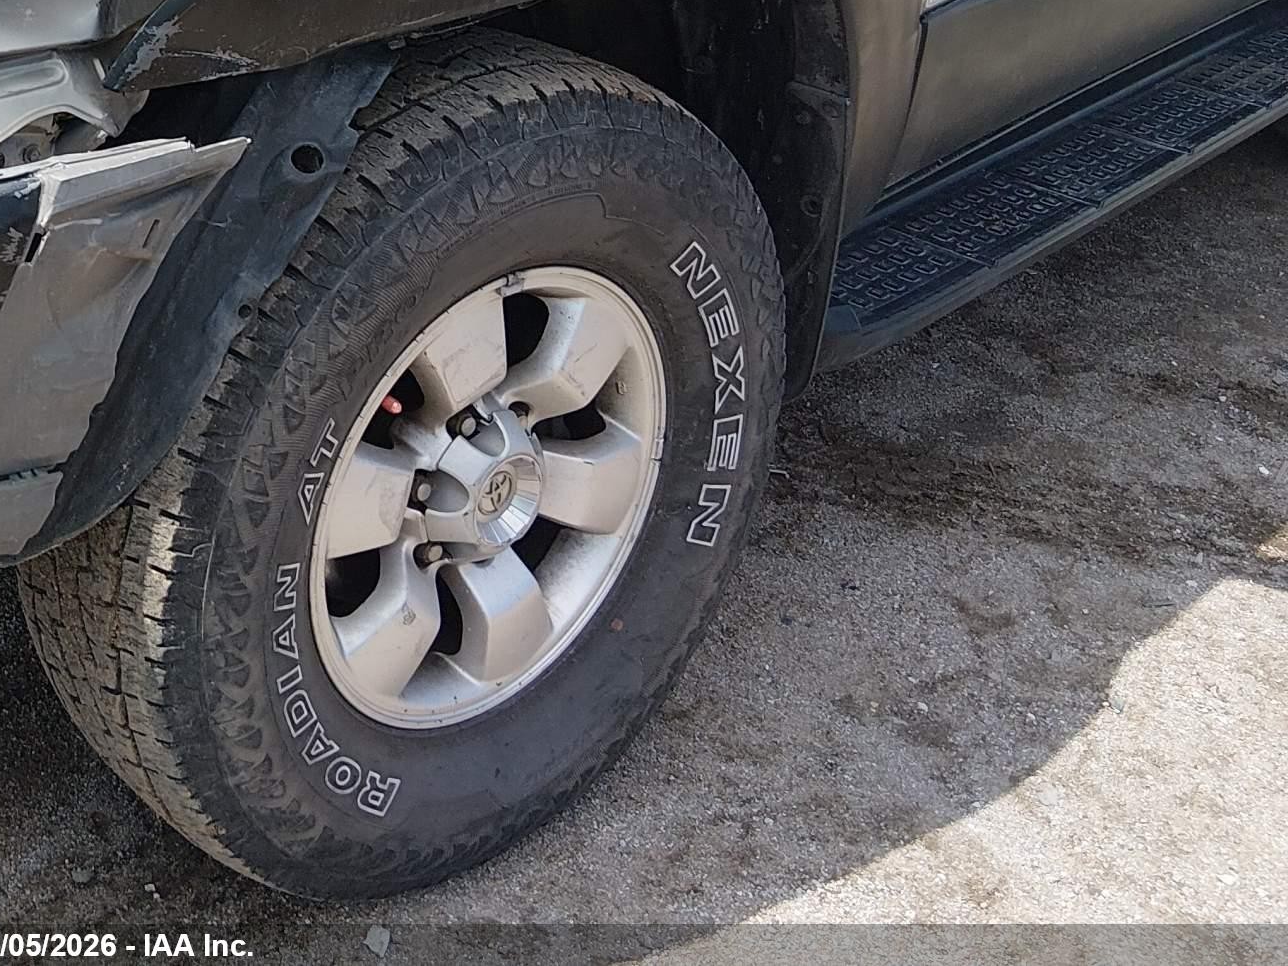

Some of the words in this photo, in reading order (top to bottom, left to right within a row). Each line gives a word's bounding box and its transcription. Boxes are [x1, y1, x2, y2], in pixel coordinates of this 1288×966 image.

[297, 417, 335, 526] AT
[669, 240, 746, 547] NEXEN
[272, 562, 401, 817] ROADIAN
